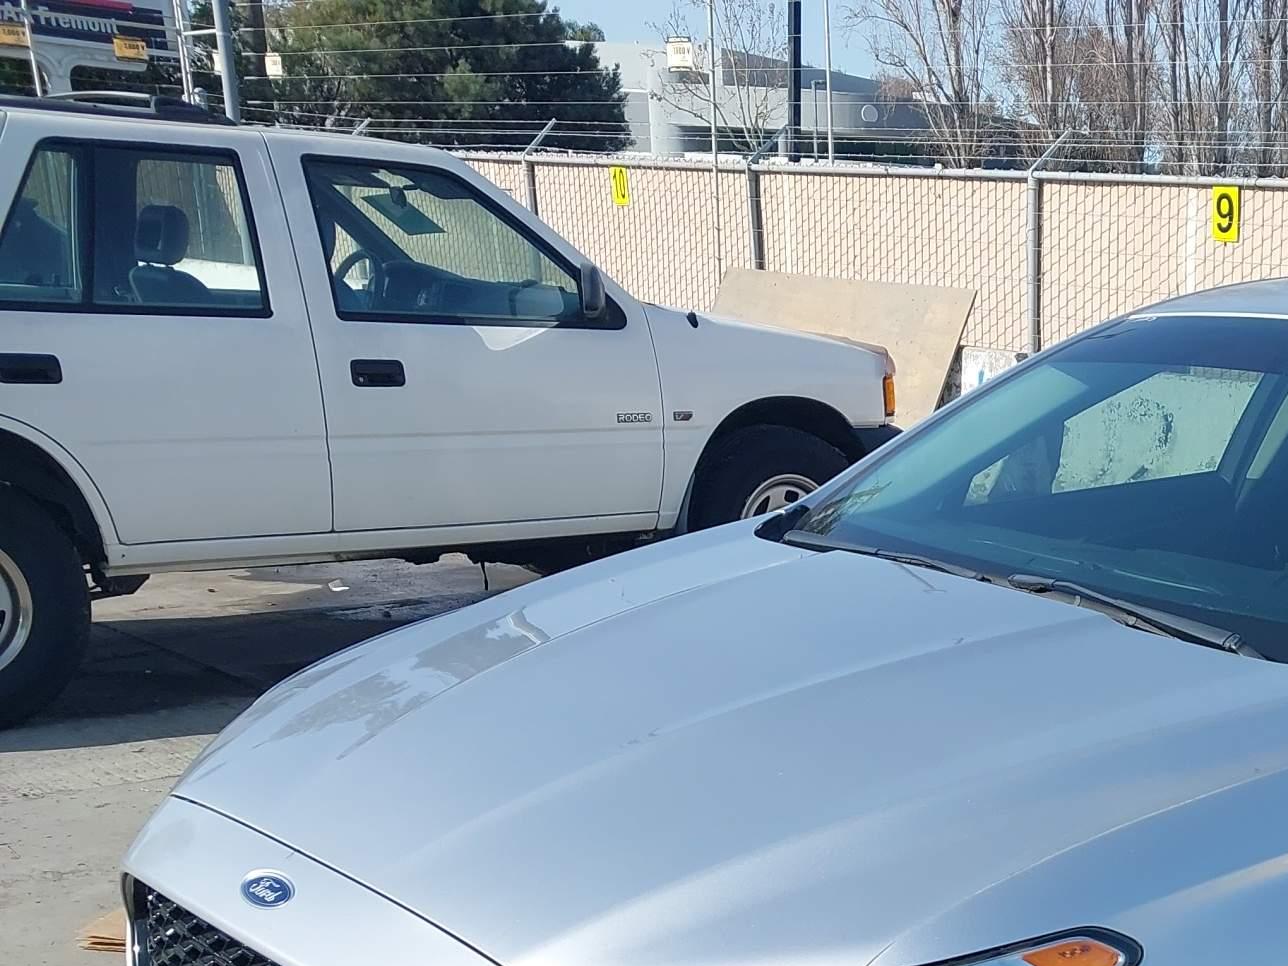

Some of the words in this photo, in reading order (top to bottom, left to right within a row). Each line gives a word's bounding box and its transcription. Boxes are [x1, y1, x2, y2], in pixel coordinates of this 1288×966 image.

[38, 6, 119, 34] Fremont
[612, 168, 626, 199] 10
[1216, 192, 1234, 234] 9
[616, 413, 652, 423] RODEO
[249, 877, 283, 902] Ford
